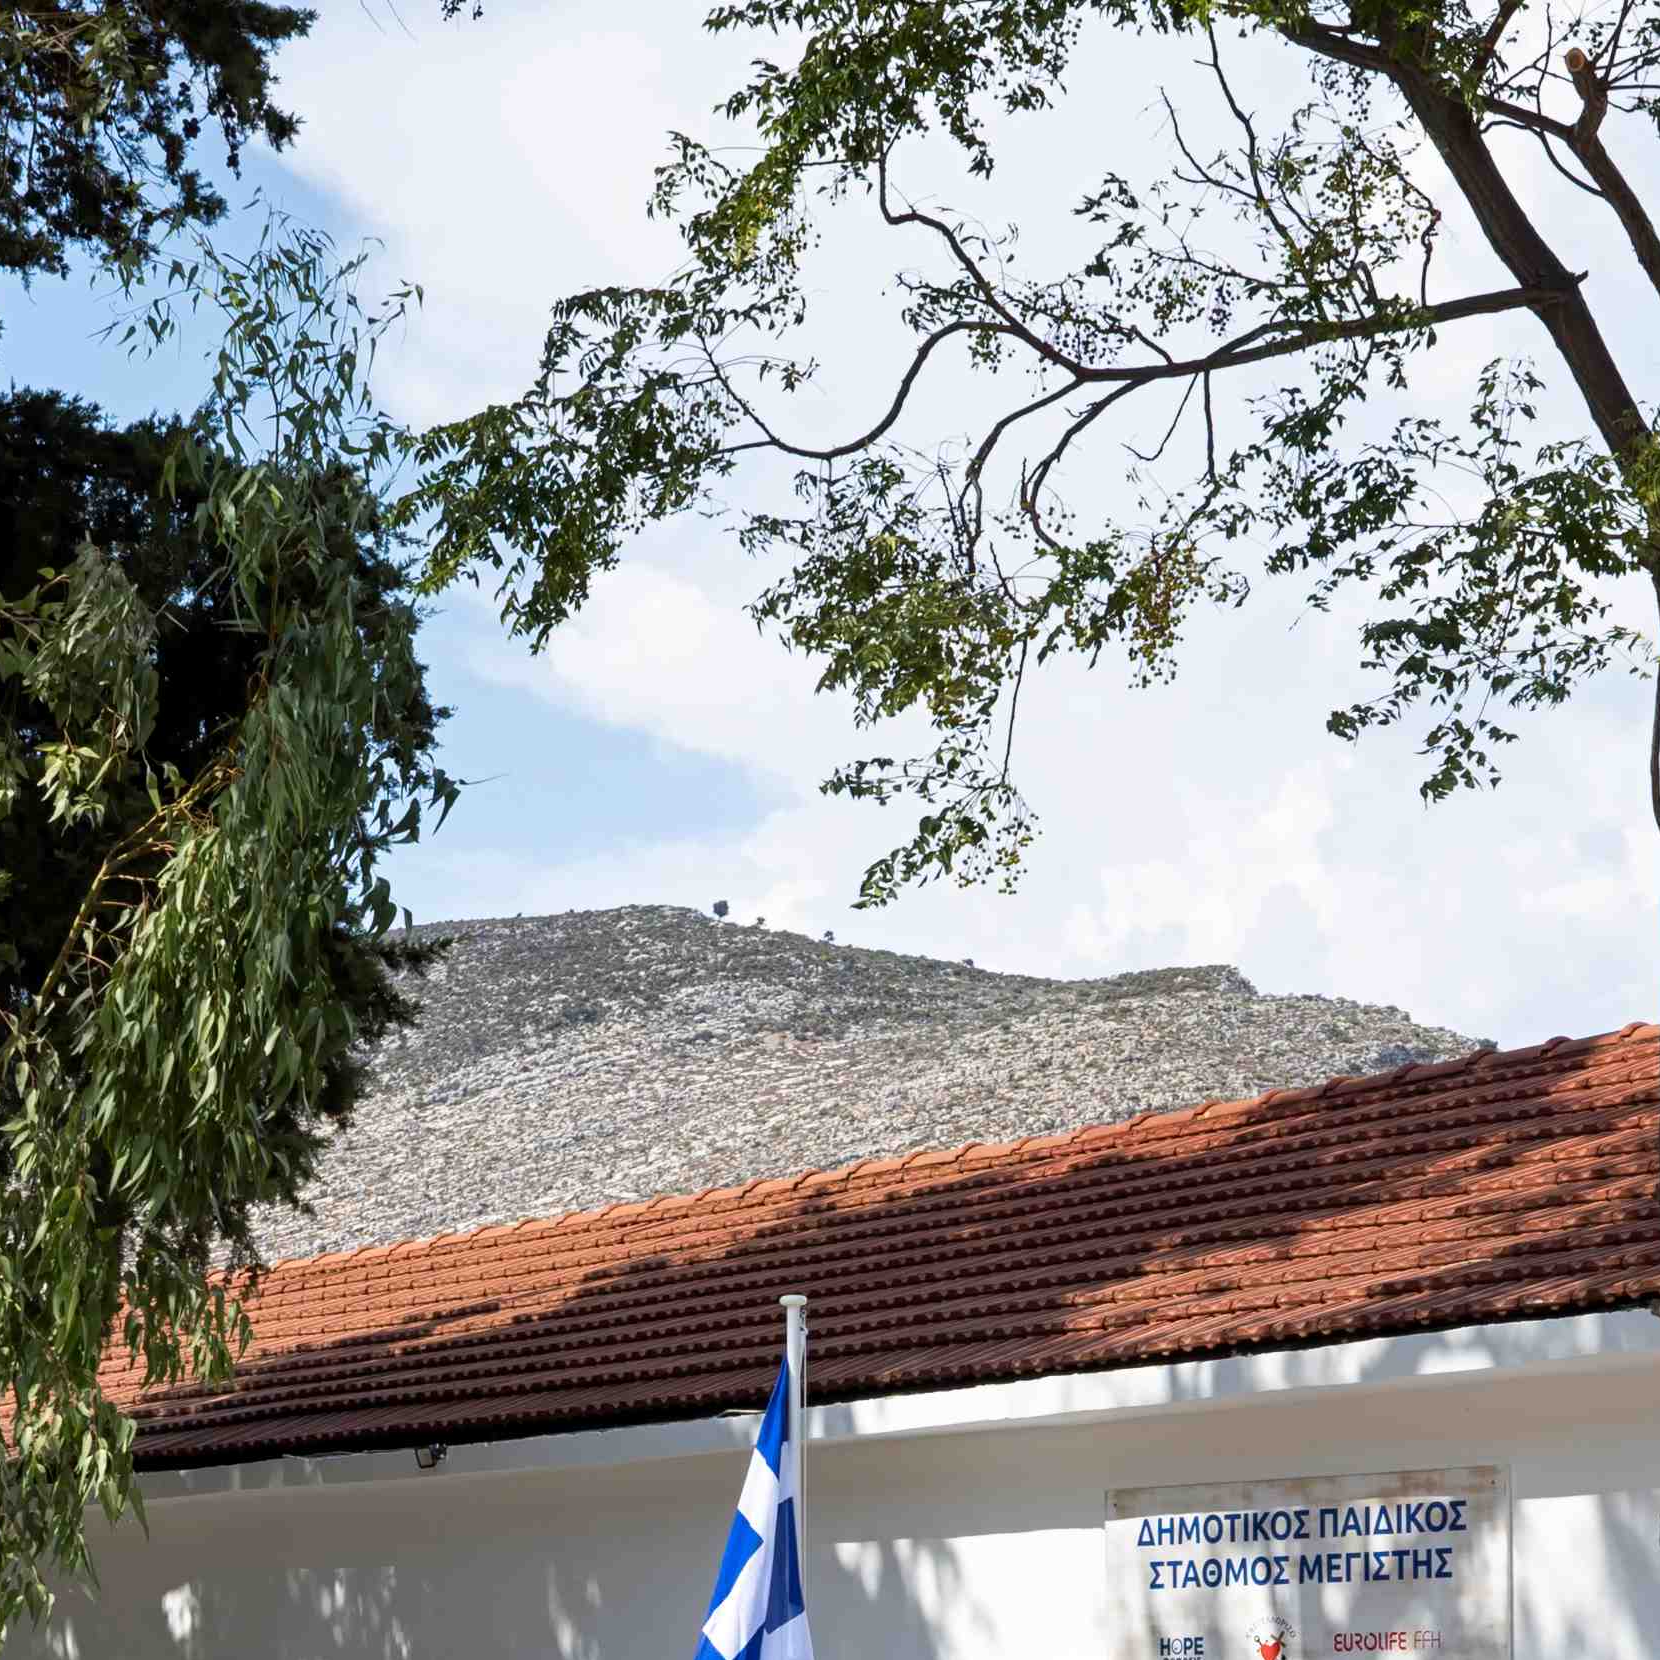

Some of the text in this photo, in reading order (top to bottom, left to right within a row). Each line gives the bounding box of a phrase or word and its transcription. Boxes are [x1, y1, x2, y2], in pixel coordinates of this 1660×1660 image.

[1137, 1500, 1467, 1547] ΔΗΜΟΤΙΚΟΣ ΠΑΙΔΙΚΟΣ
[1149, 1547, 1453, 1590] ΣΤΑΘΜΟΣ ΜΕΓΙΣΤΗΣ
[1160, 1636, 1204, 1656] HOPE
[1333, 1631, 1407, 1652] EUROLIFE
